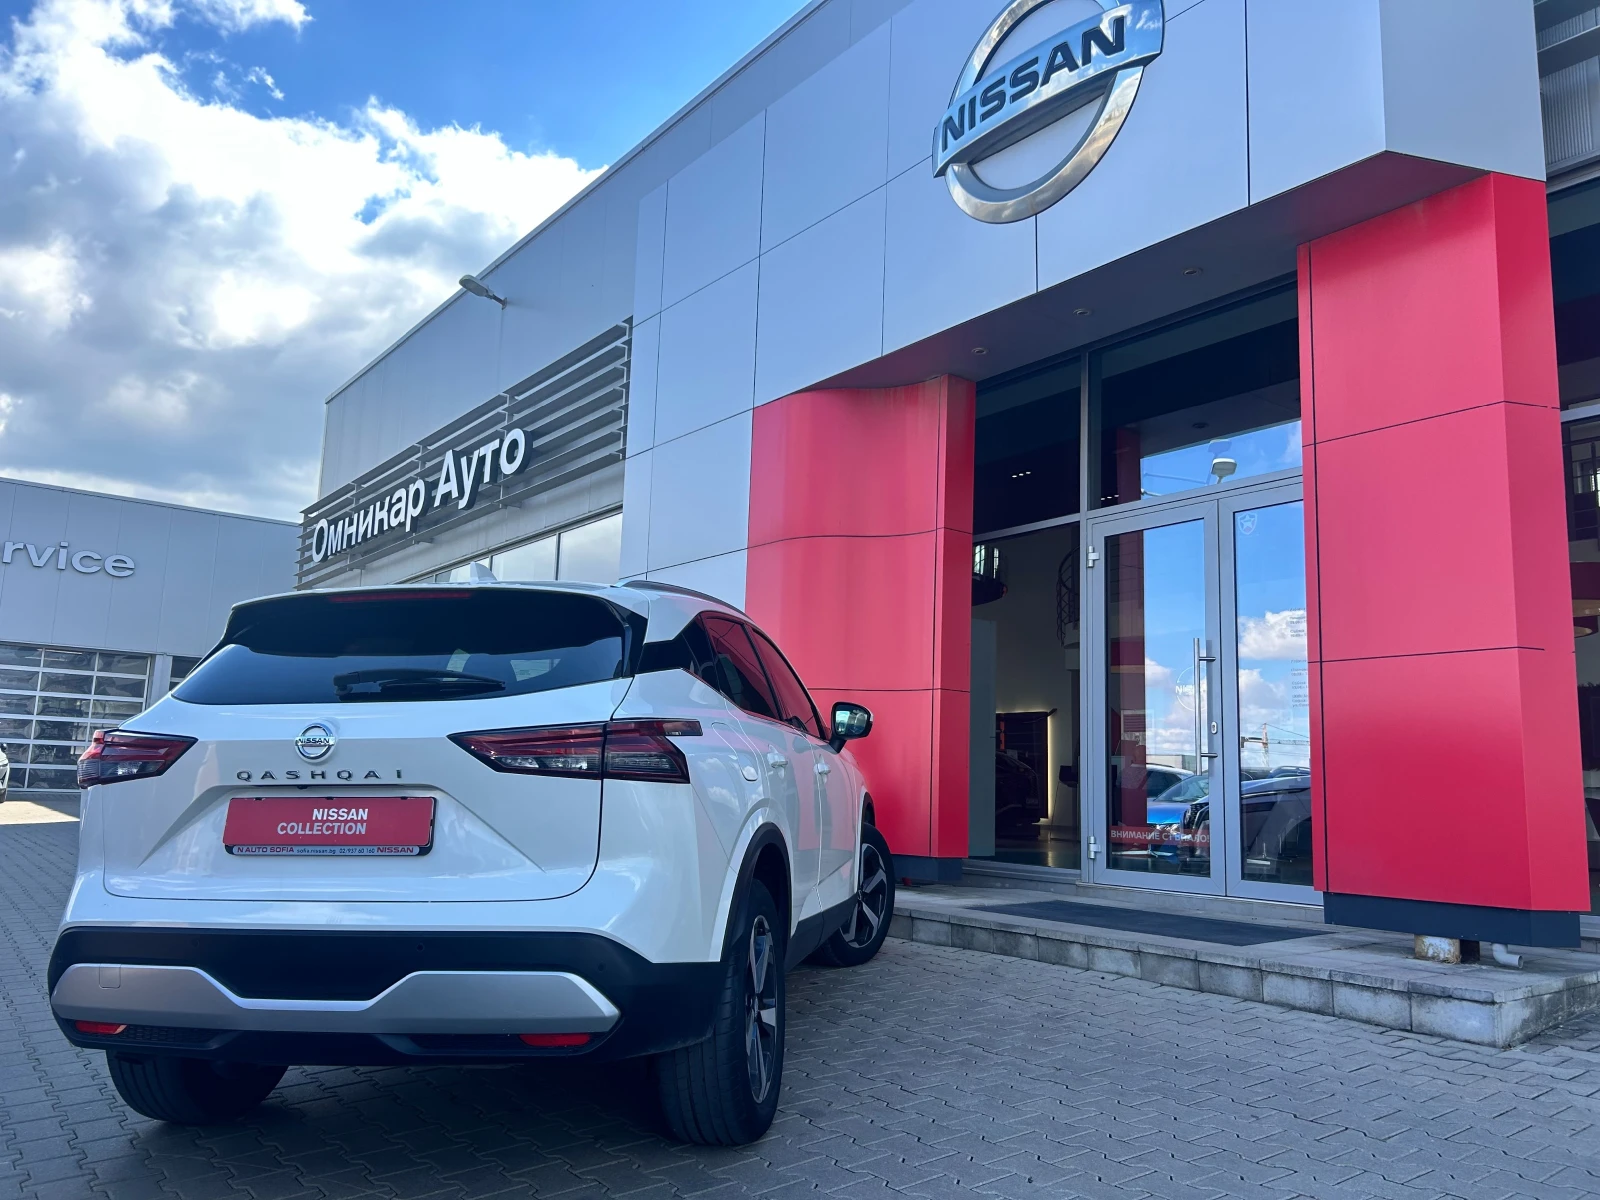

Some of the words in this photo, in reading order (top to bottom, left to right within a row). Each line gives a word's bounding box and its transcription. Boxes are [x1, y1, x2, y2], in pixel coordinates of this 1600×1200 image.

[942, 15, 1126, 153] NISSAN
[312, 478, 426, 563] Омникар
[433, 428, 526, 510] Ауто
[236, 770, 403, 781] QASHQAI
[312, 808, 369, 820] NISSAN
[277, 822, 367, 835] COLLECTION
[1110, 830, 1160, 840] ВНИМАНИЕ
